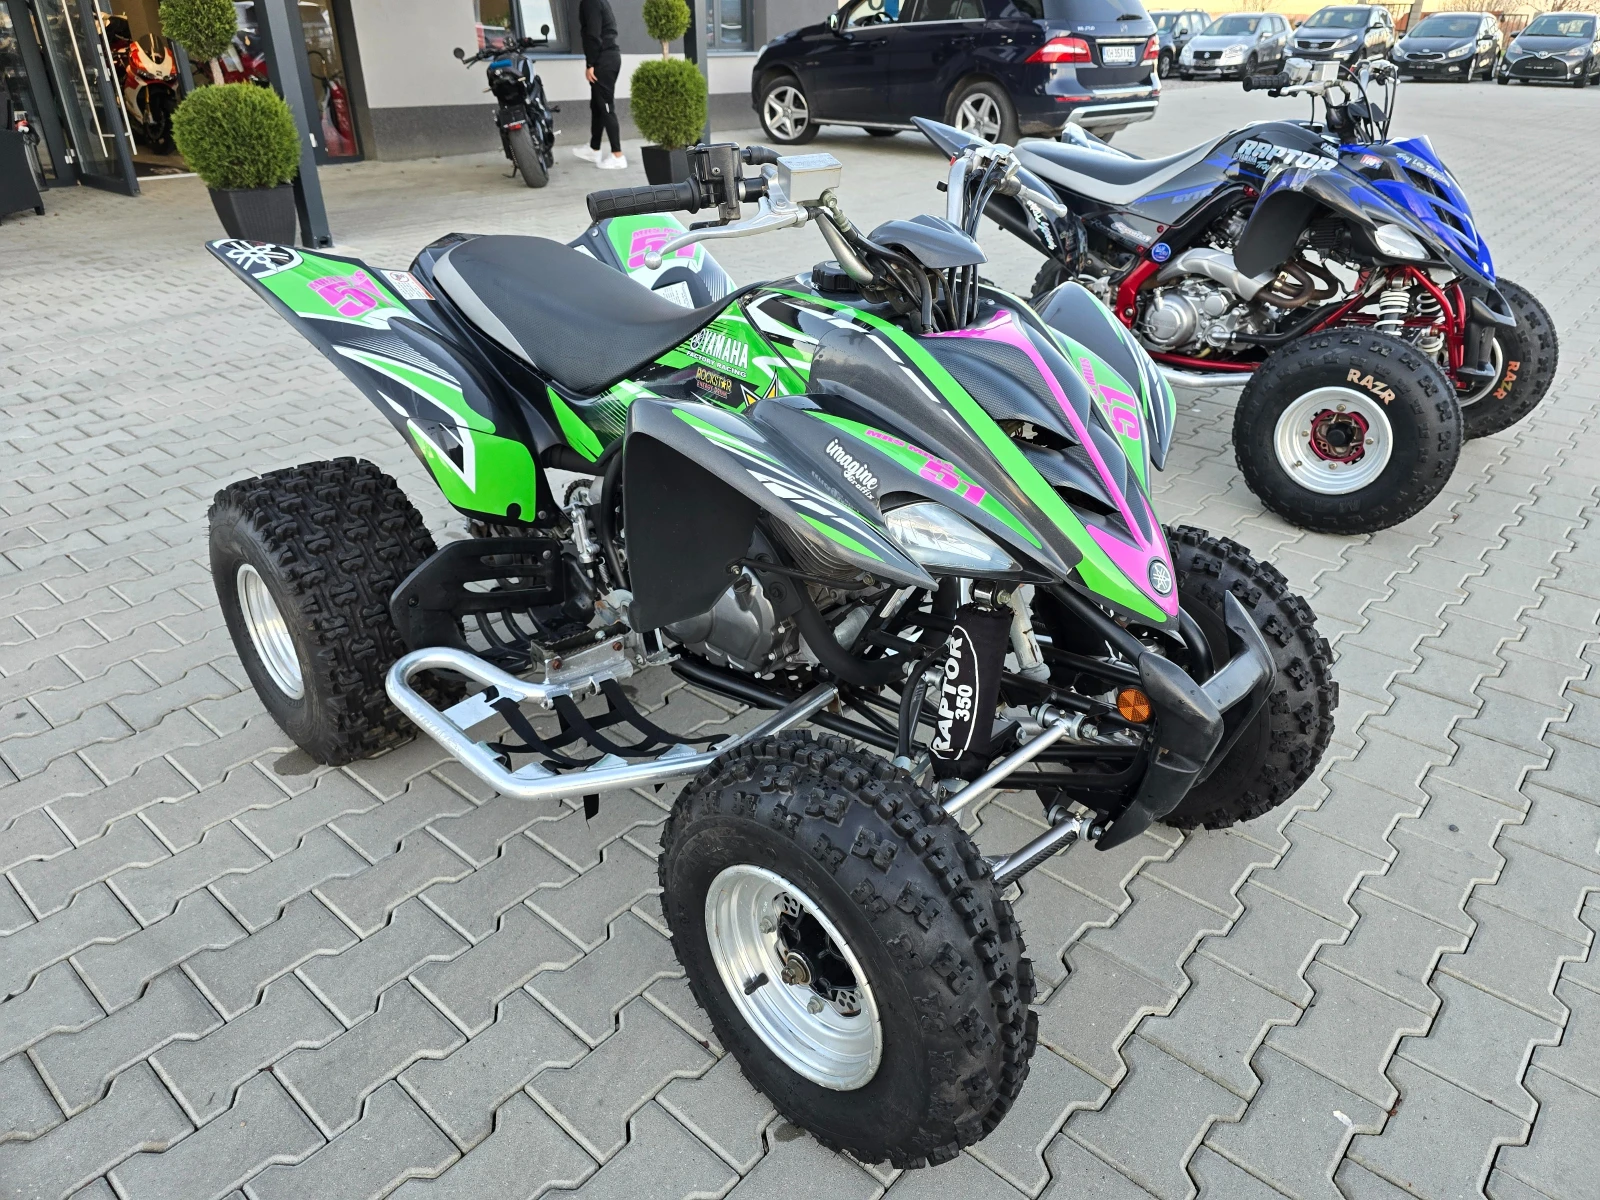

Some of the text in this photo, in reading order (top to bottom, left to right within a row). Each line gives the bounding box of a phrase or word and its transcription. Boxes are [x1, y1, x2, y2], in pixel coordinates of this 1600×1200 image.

[1237, 139, 1339, 171] RAPTOR
[686, 350, 747, 378] FACTORY RACING
[700, 329, 749, 370] YAMAHA
[1347, 368, 1396, 406] RAZR
[1492, 360, 1521, 400] RAZR
[1098, 383, 1141, 441] 51
[865, 429, 905, 447] MRS
[825, 438, 879, 491] imagine
[919, 459, 988, 506] 51
[848, 474, 875, 501] Graffix
[931, 636, 963, 751] RAPTOR
[955, 684, 974, 722] 350
